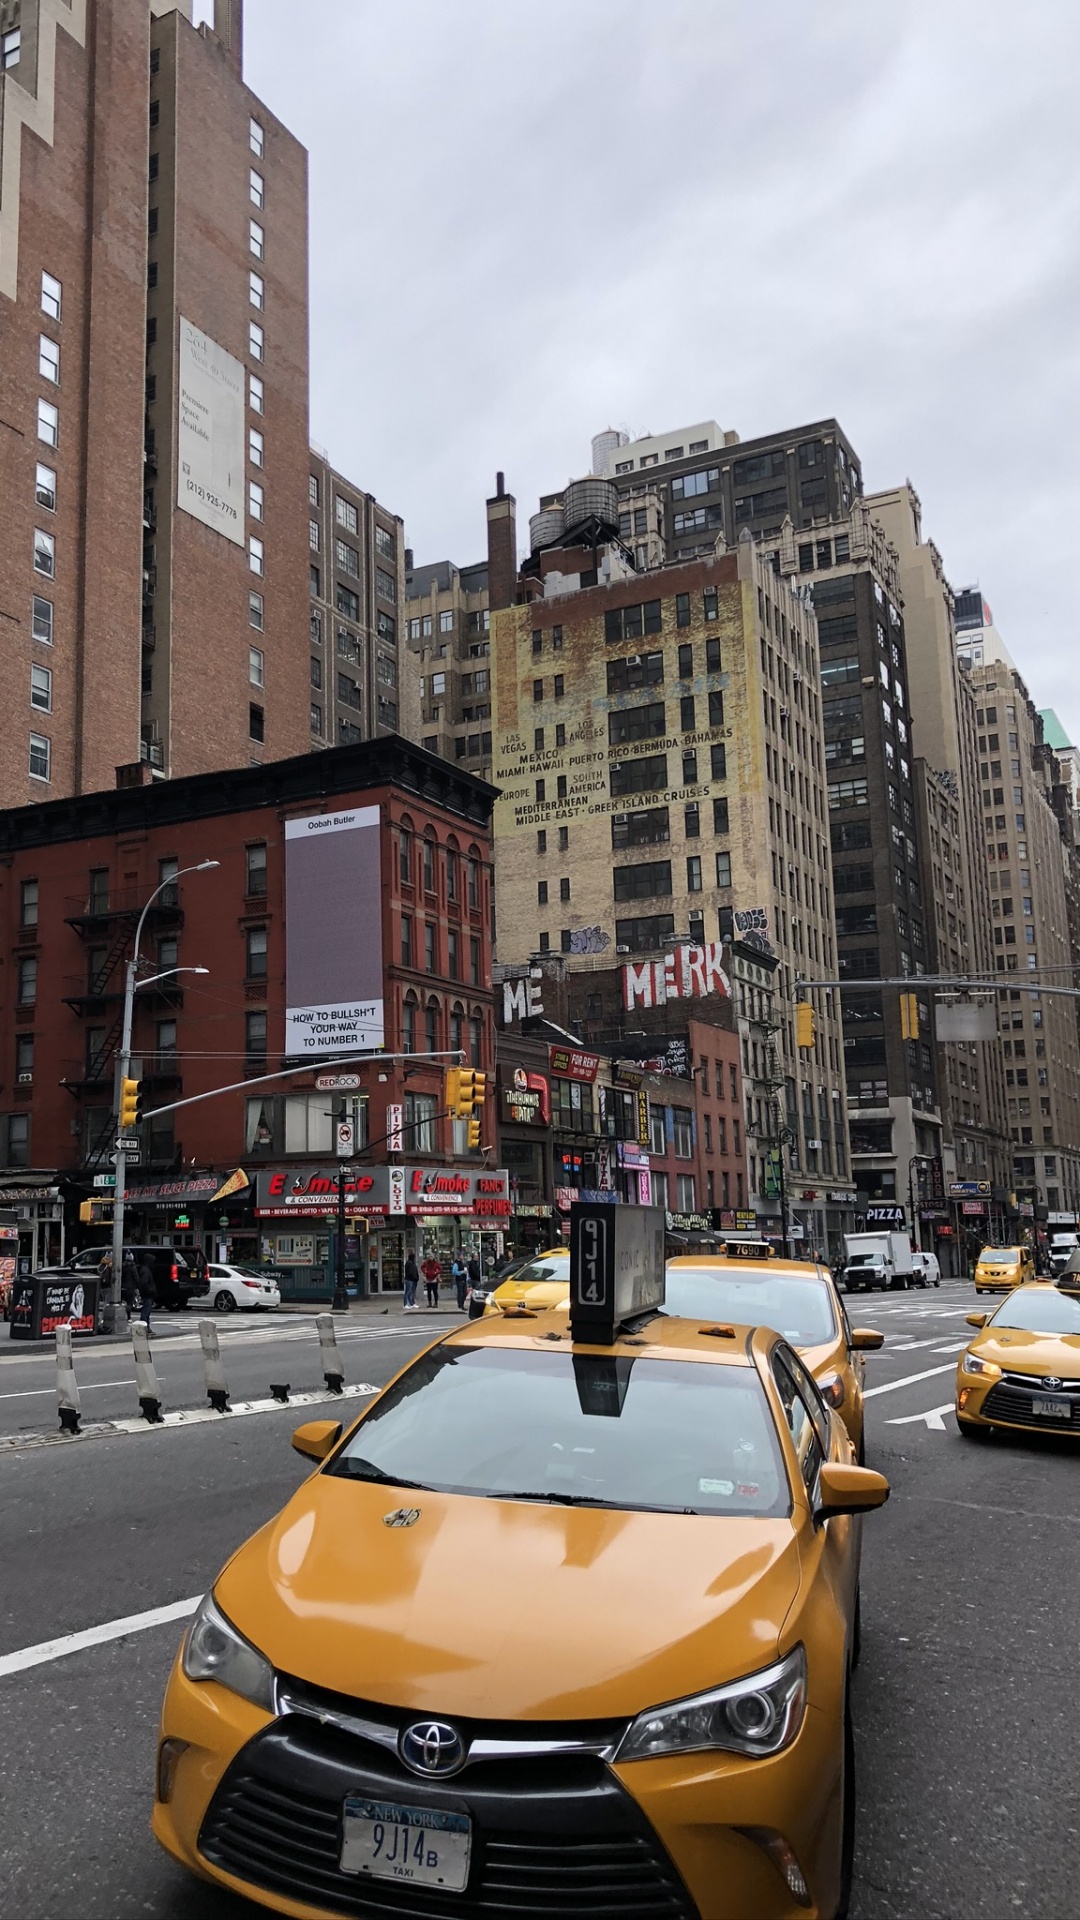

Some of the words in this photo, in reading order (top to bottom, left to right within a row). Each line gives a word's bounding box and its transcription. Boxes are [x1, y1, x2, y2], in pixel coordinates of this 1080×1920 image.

[186, 327, 207, 354] 264
[190, 347, 209, 370] West
[220, 372, 240, 392] Street
[181, 388, 210, 415] Premiere
[181, 402, 200, 421] Space
[181, 416, 210, 442] Available
[186, 479, 206, 500] (212)
[206, 492, 238, 520] 925-7778
[578, 721, 594, 731] LOS
[506, 733, 521, 744] LAS
[569, 727, 604, 743] ANGELES
[496, 767, 526, 780] MIAMI
[529, 759, 564, 774] HAWAII
[569, 752, 604, 767] PUERTO
[607, 746, 629, 759] RICO
[633, 738, 679, 754] BERMUDA
[685, 727, 733, 746] BAHAMAS
[501, 742, 527, 755] VEGAS
[519, 750, 559, 765] MEXICO
[573, 771, 603, 784] SOUTH
[499, 788, 530, 801] EUROPE
[569, 781, 606, 796] AMERICA
[514, 796, 588, 816] MEDITERRANEAN
[515, 812, 551, 826] MIDDLE
[555, 808, 579, 820] EAST
[588, 802, 619, 814] GREEK
[622, 795, 659, 809] ISLAND
[663, 786, 710, 802] CRUISES
[308, 818, 332, 830] Oobah
[333, 815, 356, 827] Butler
[622, 942, 732, 1011] MERK
[293, 1013, 314, 1023] HOW
[316, 1011, 328, 1021] TO
[310, 1023, 336, 1034] YOUR
[338, 1021, 358, 1031] WAY
[303, 1037, 316, 1047] TO
[317, 1035, 358, 1046] NUMBER
[361, 1034, 365, 1042] 1
[572, 1054, 582, 1066] FOR
[583, 1057, 598, 1069] RENT
[320, 1078, 357, 1087] REDROCK
[639, 1092, 648, 1140] BARBER
[268, 1173, 287, 1195] E
[411, 1170, 424, 1191] E
[479, 1179, 505, 1193] FANCY
[933, 1159, 942, 1197] LIQUOR
[142, 1186, 159, 1197] MY
[161, 1182, 186, 1195] SLICE
[187, 1178, 218, 1192] PIZZA
[393, 1184, 402, 1210] LOTTO
[475, 1198, 512, 1216] PERFUMES
[867, 1207, 903, 1220] PIZZA
[736, 1245, 760, 1256] 7G90
[585, 1220, 598, 1301] 9J14
[260, 1271, 282, 1279] Subway
[374, 1806, 401, 1822] NEW
[407, 1812, 440, 1829] YORK
[393, 1867, 414, 1877] TAXI
